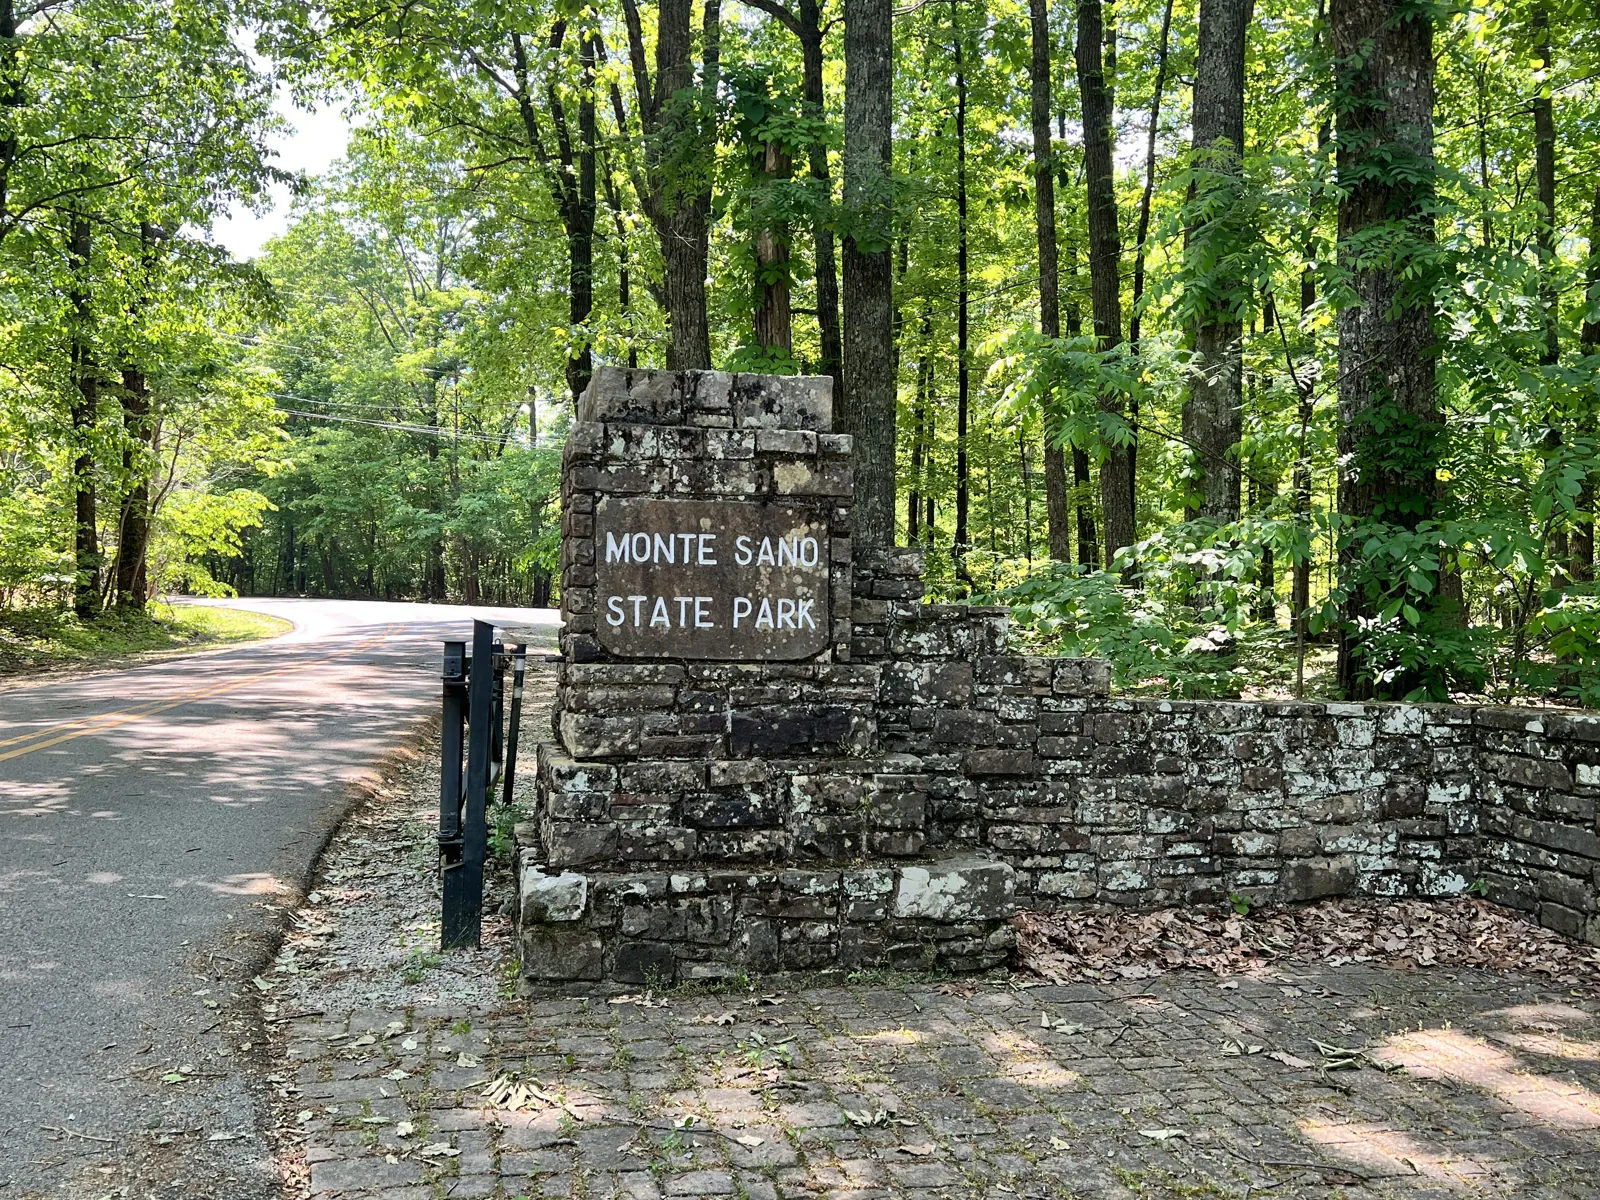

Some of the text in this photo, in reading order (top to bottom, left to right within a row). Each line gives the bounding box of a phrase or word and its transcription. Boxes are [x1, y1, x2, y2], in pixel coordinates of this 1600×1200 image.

[605, 531, 819, 567] MONTE SANO
[605, 595, 816, 629] STATE PARK
